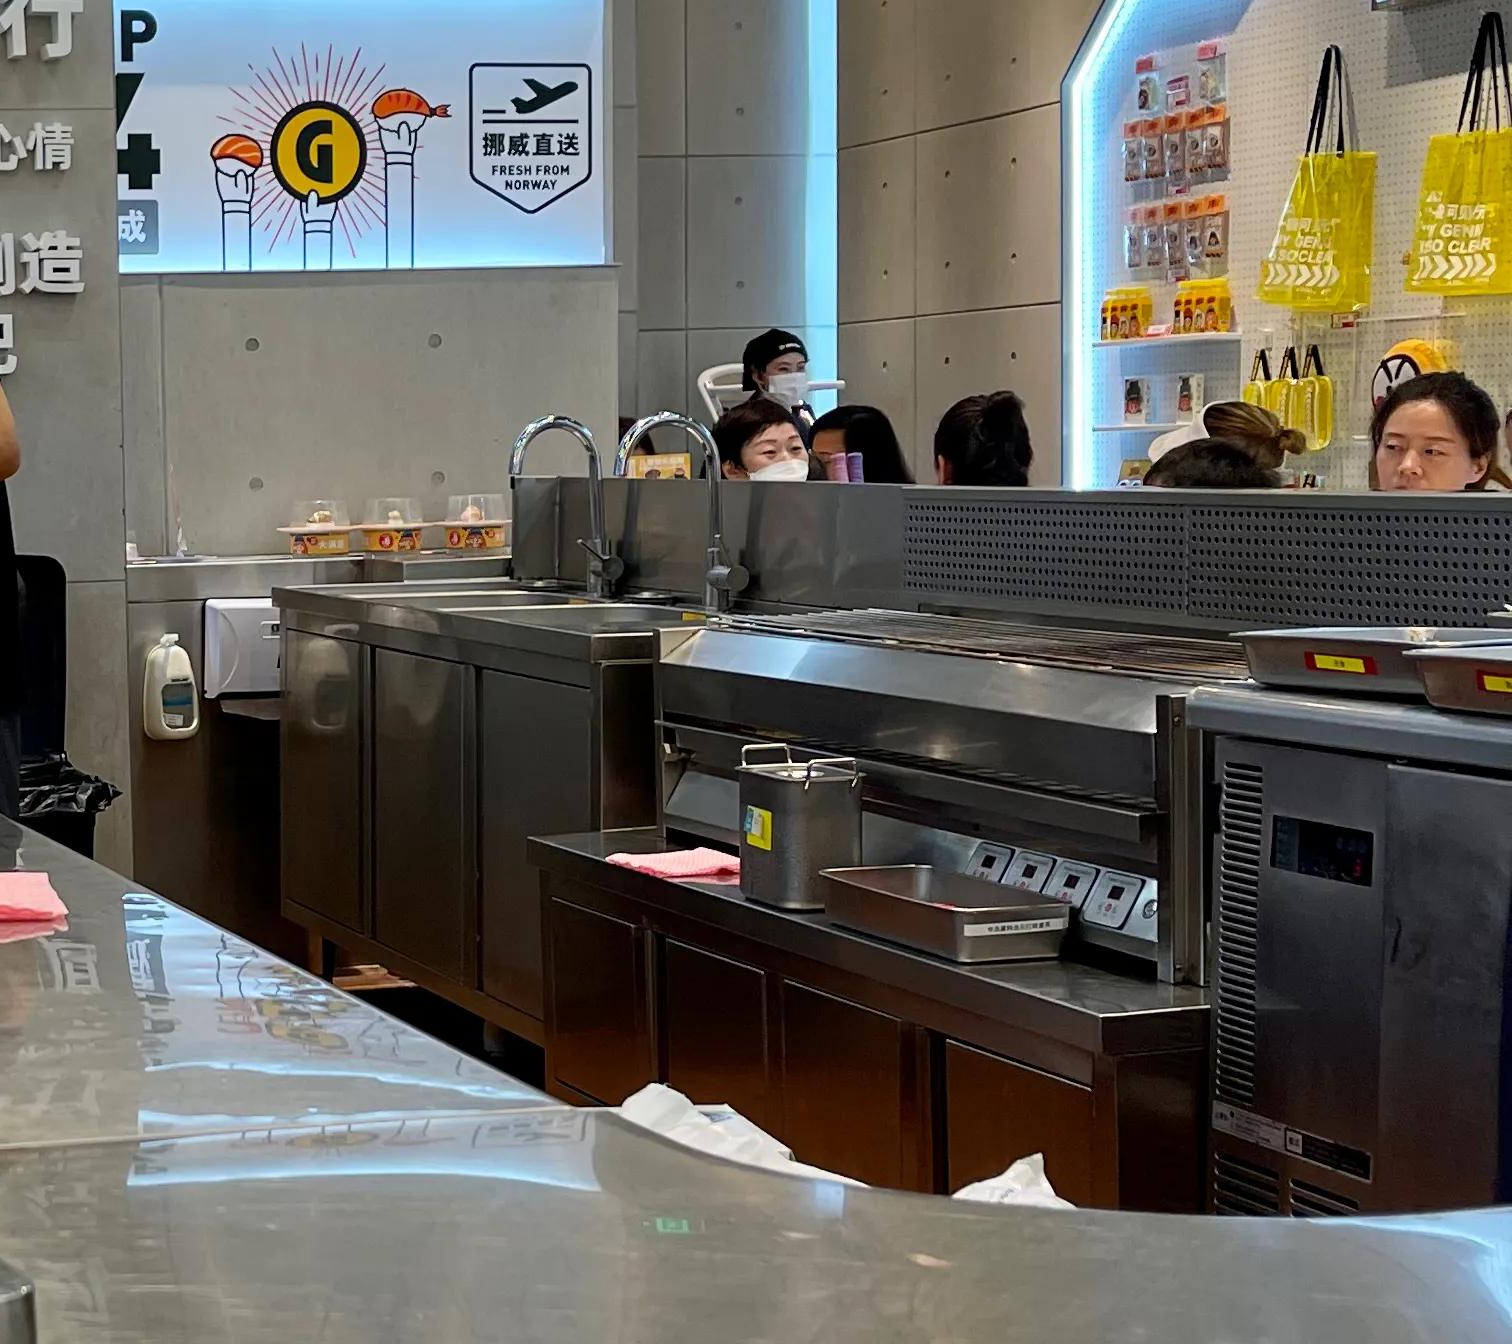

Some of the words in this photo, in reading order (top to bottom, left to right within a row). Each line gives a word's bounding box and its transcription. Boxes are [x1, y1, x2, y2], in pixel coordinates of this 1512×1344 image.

[482, 132, 580, 156] 挪威直送
[491, 164, 532, 176] FRESH
[535, 164, 570, 176] FROM
[504, 178, 558, 191] NORWAY
